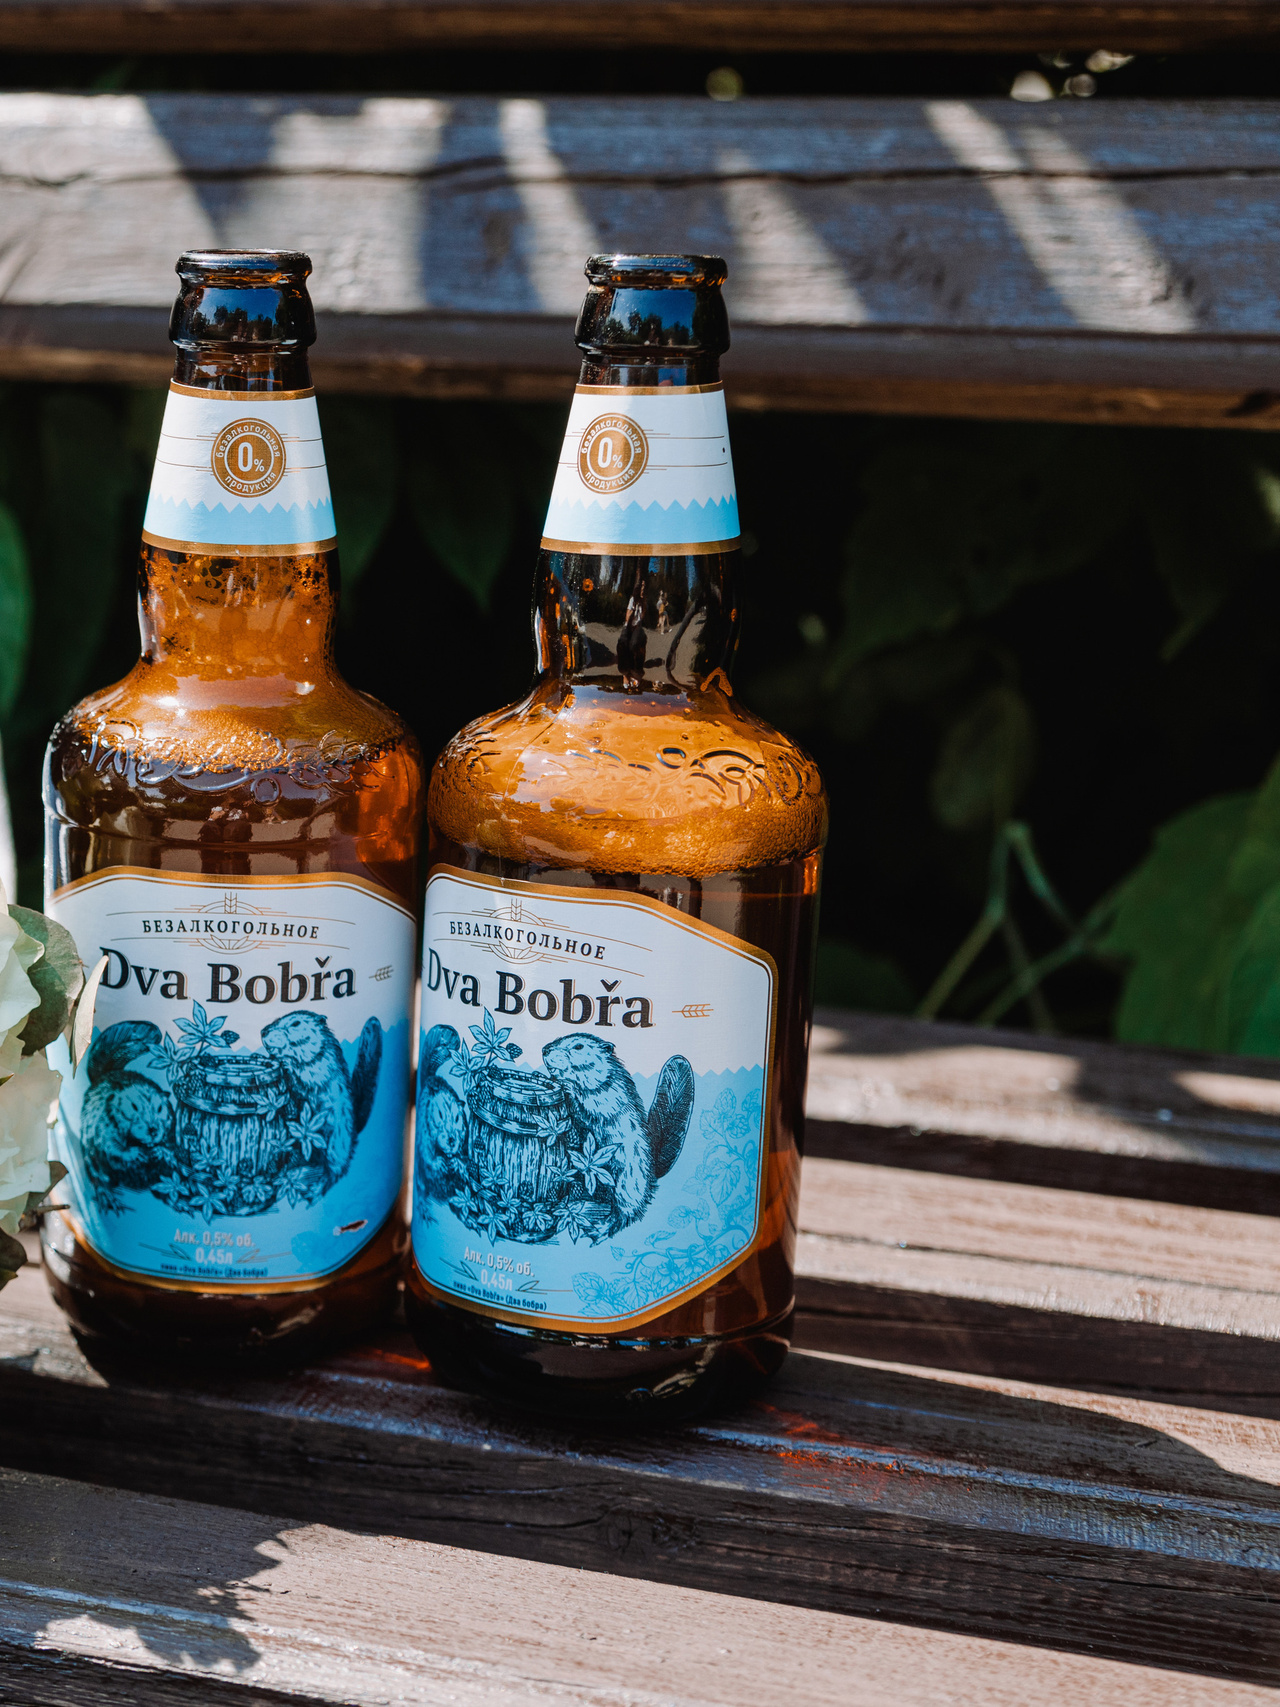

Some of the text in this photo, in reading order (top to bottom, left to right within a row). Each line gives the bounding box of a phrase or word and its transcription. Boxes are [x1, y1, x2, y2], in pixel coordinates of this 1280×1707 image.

[216, 424, 281, 458] безалкогольная
[581, 420, 642, 454] безалкогольная
[238, 441, 265, 472] 0%
[597, 437, 623, 469] 0%
[225, 472, 277, 493] продукция
[585, 468, 635, 490] продукция
[142, 919, 320, 939] БЕЗАЛКОГОЛЬНОЕ
[449, 921, 605, 960] БЕЗАЛКОГОЛЬНОЕ
[99, 946, 358, 1005] Dva Bobřa
[427, 947, 656, 1028] Dva Bobřa
[174, 1228, 257, 1247] Алк. 0,5% об.
[195, 1247, 233, 1265] 0,45л
[464, 1246, 535, 1277] Алк. 0,5% об.
[480, 1269, 513, 1292] 0,45л
[522, 1298, 548, 1312] бобра)
